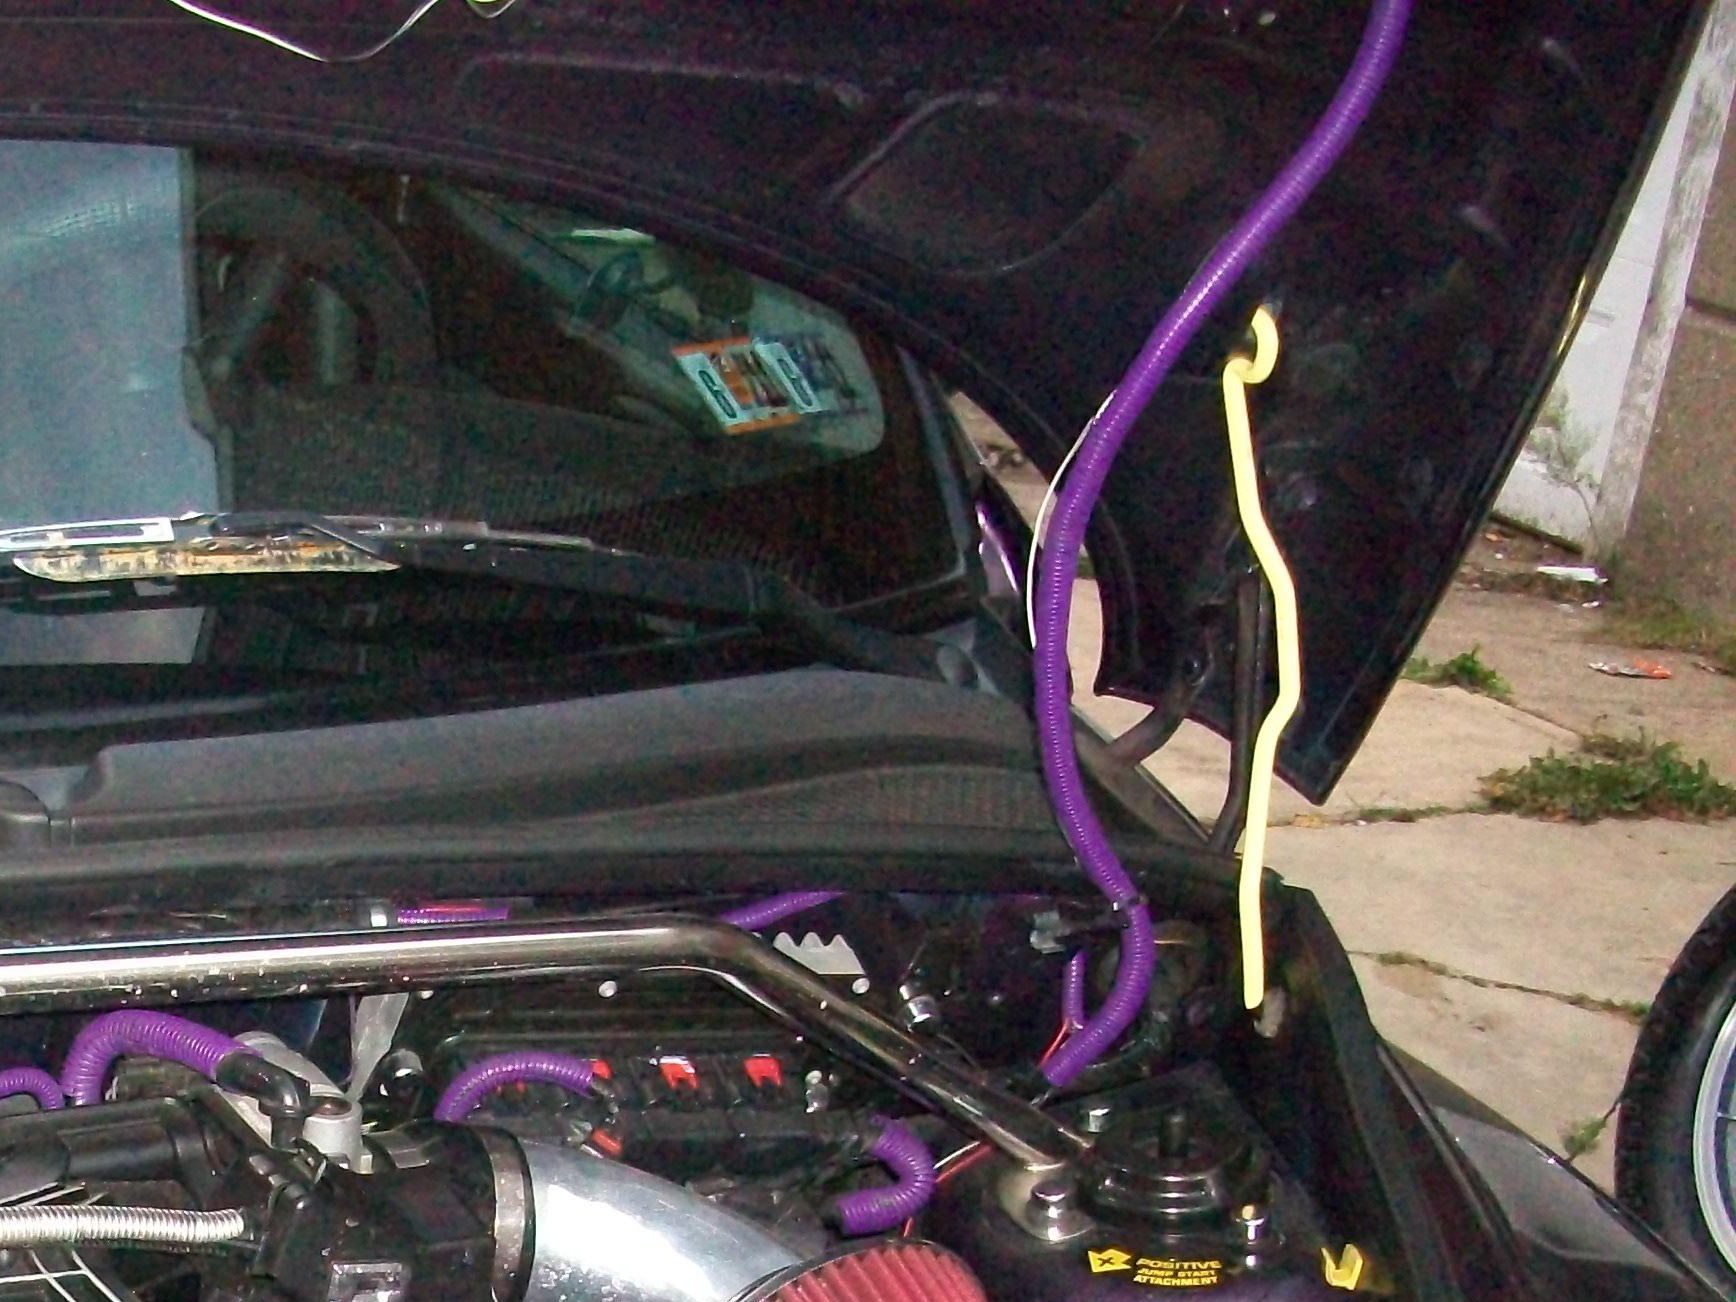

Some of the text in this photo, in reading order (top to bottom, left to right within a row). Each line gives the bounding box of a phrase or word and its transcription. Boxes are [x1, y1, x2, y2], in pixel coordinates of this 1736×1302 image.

[1136, 1258, 1222, 1270] POSITIVE
[1137, 1268, 1215, 1278] JUMP START
[1133, 1275, 1218, 1286] ATTACHMENT
